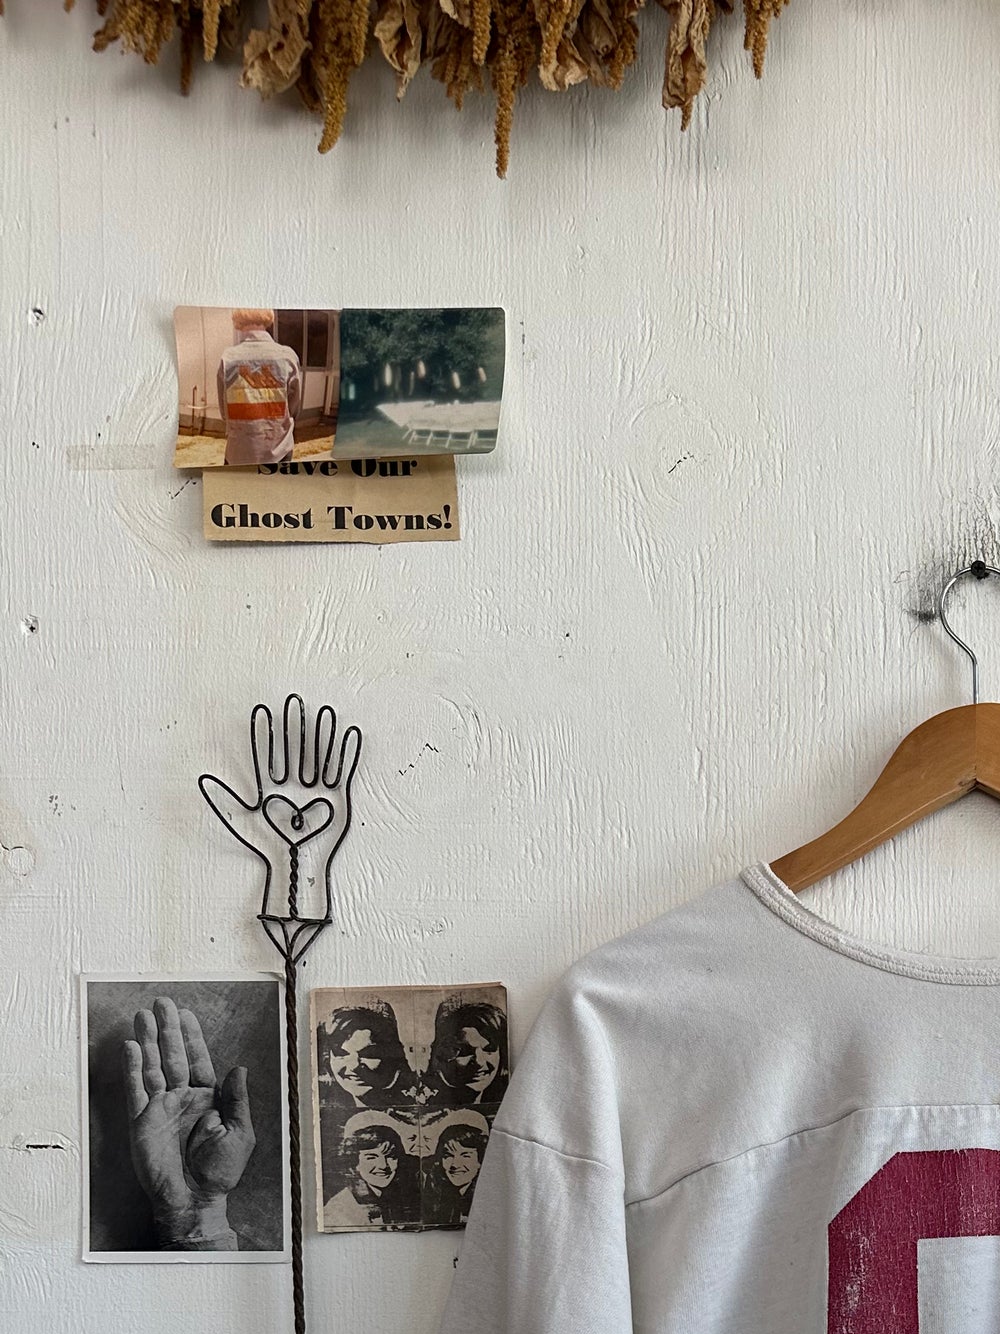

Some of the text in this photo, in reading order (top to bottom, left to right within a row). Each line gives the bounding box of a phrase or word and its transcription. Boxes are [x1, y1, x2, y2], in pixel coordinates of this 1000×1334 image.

[351, 458, 418, 477] Our
[211, 503, 453, 530] Ghost Towns!
